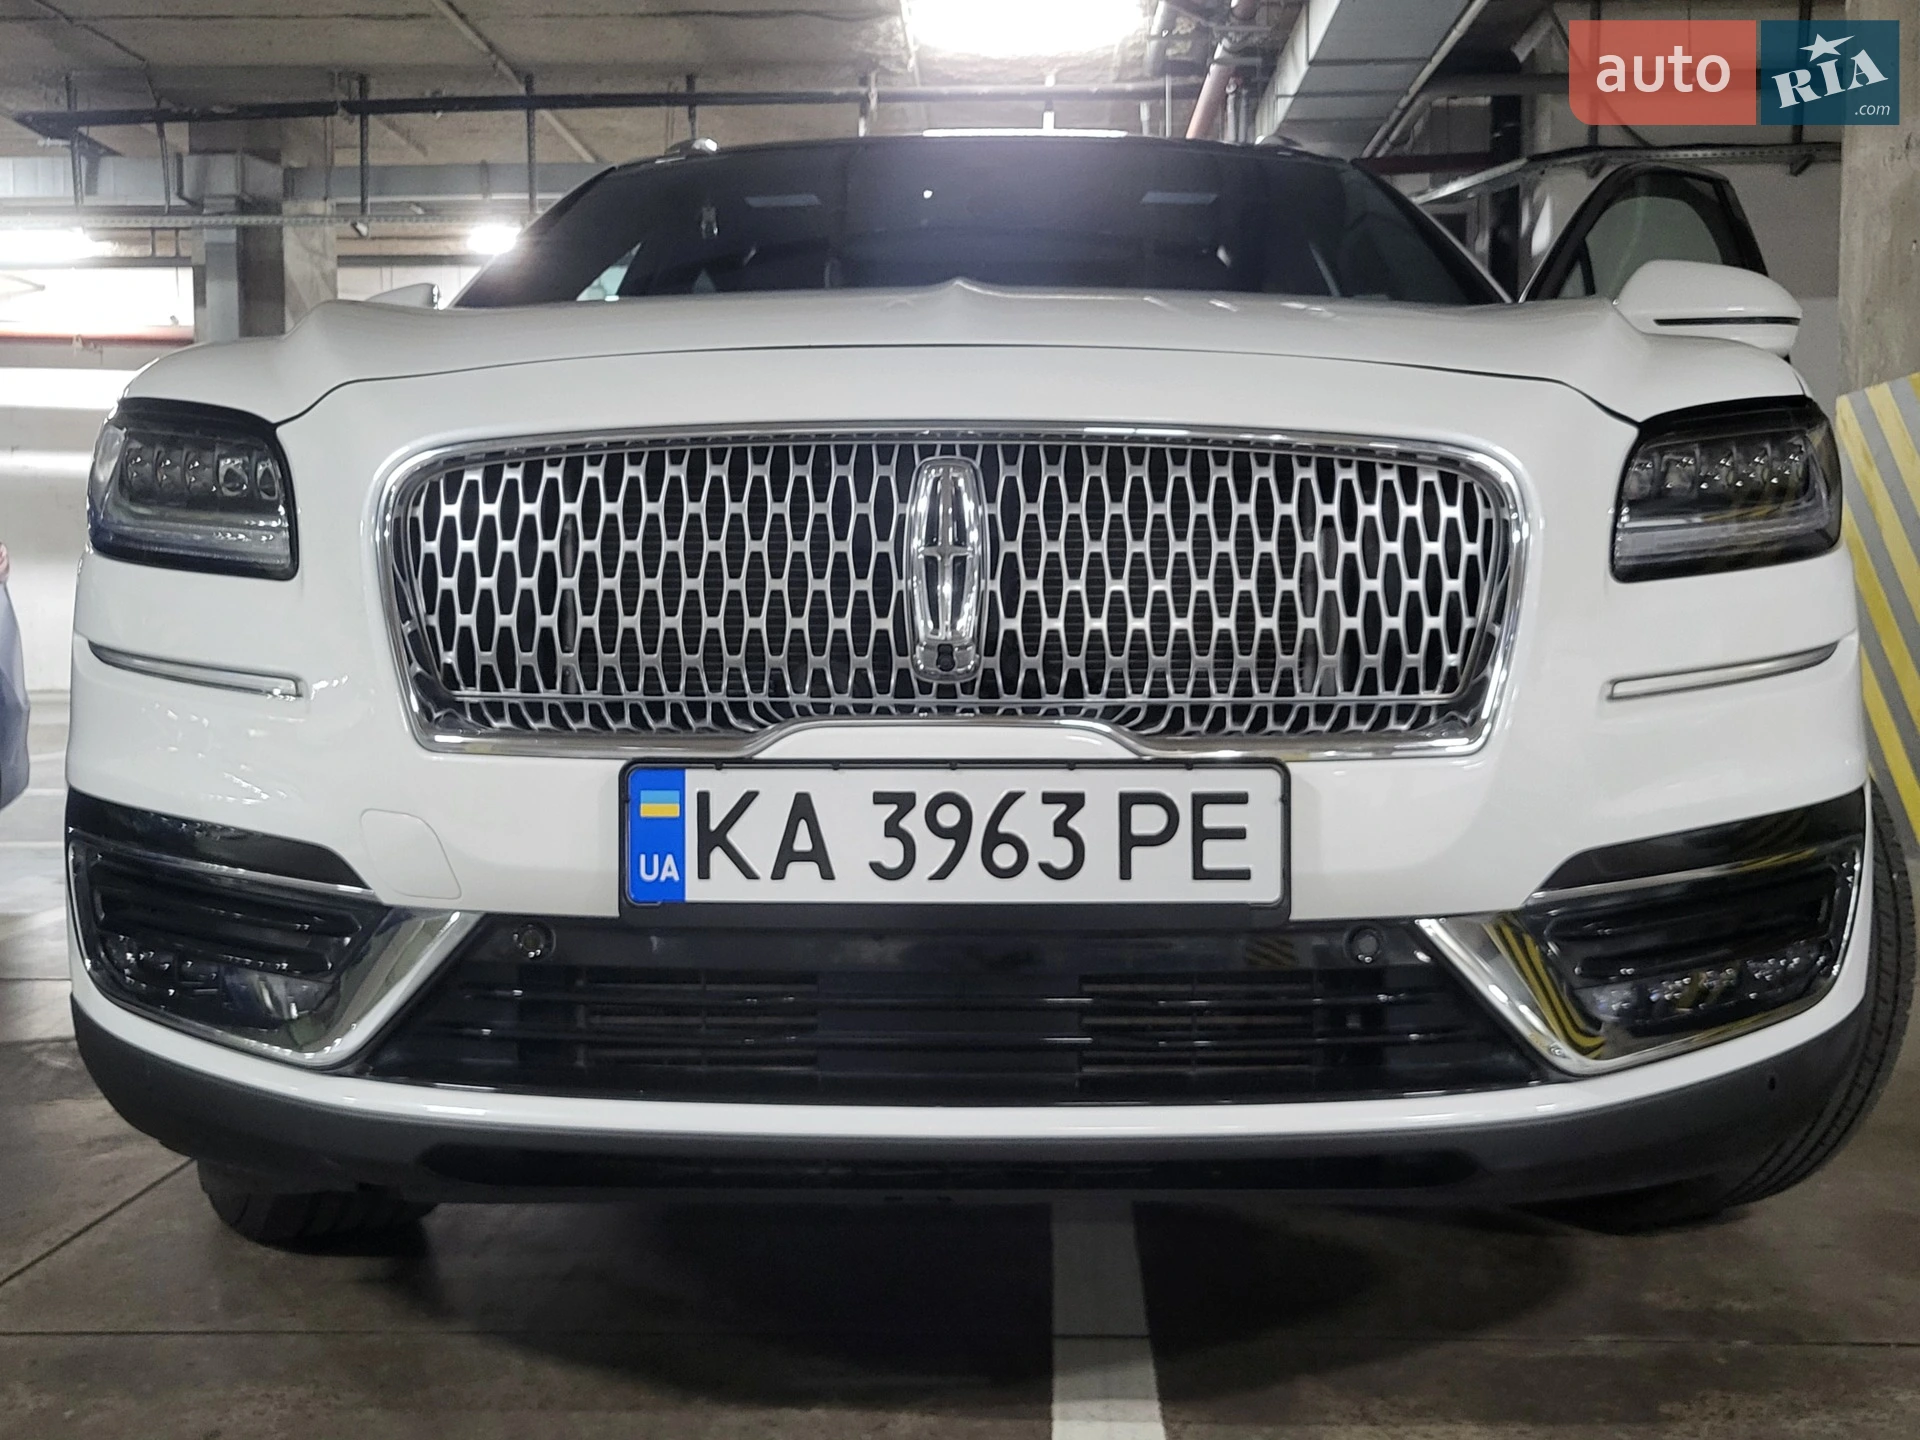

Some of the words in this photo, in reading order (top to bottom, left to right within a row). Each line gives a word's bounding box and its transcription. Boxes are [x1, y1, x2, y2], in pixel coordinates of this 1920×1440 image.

[696, 790, 836, 881] KA
[868, 790, 1086, 881] 3963
[1118, 790, 1252, 881] PE
[639, 854, 681, 883] UA
